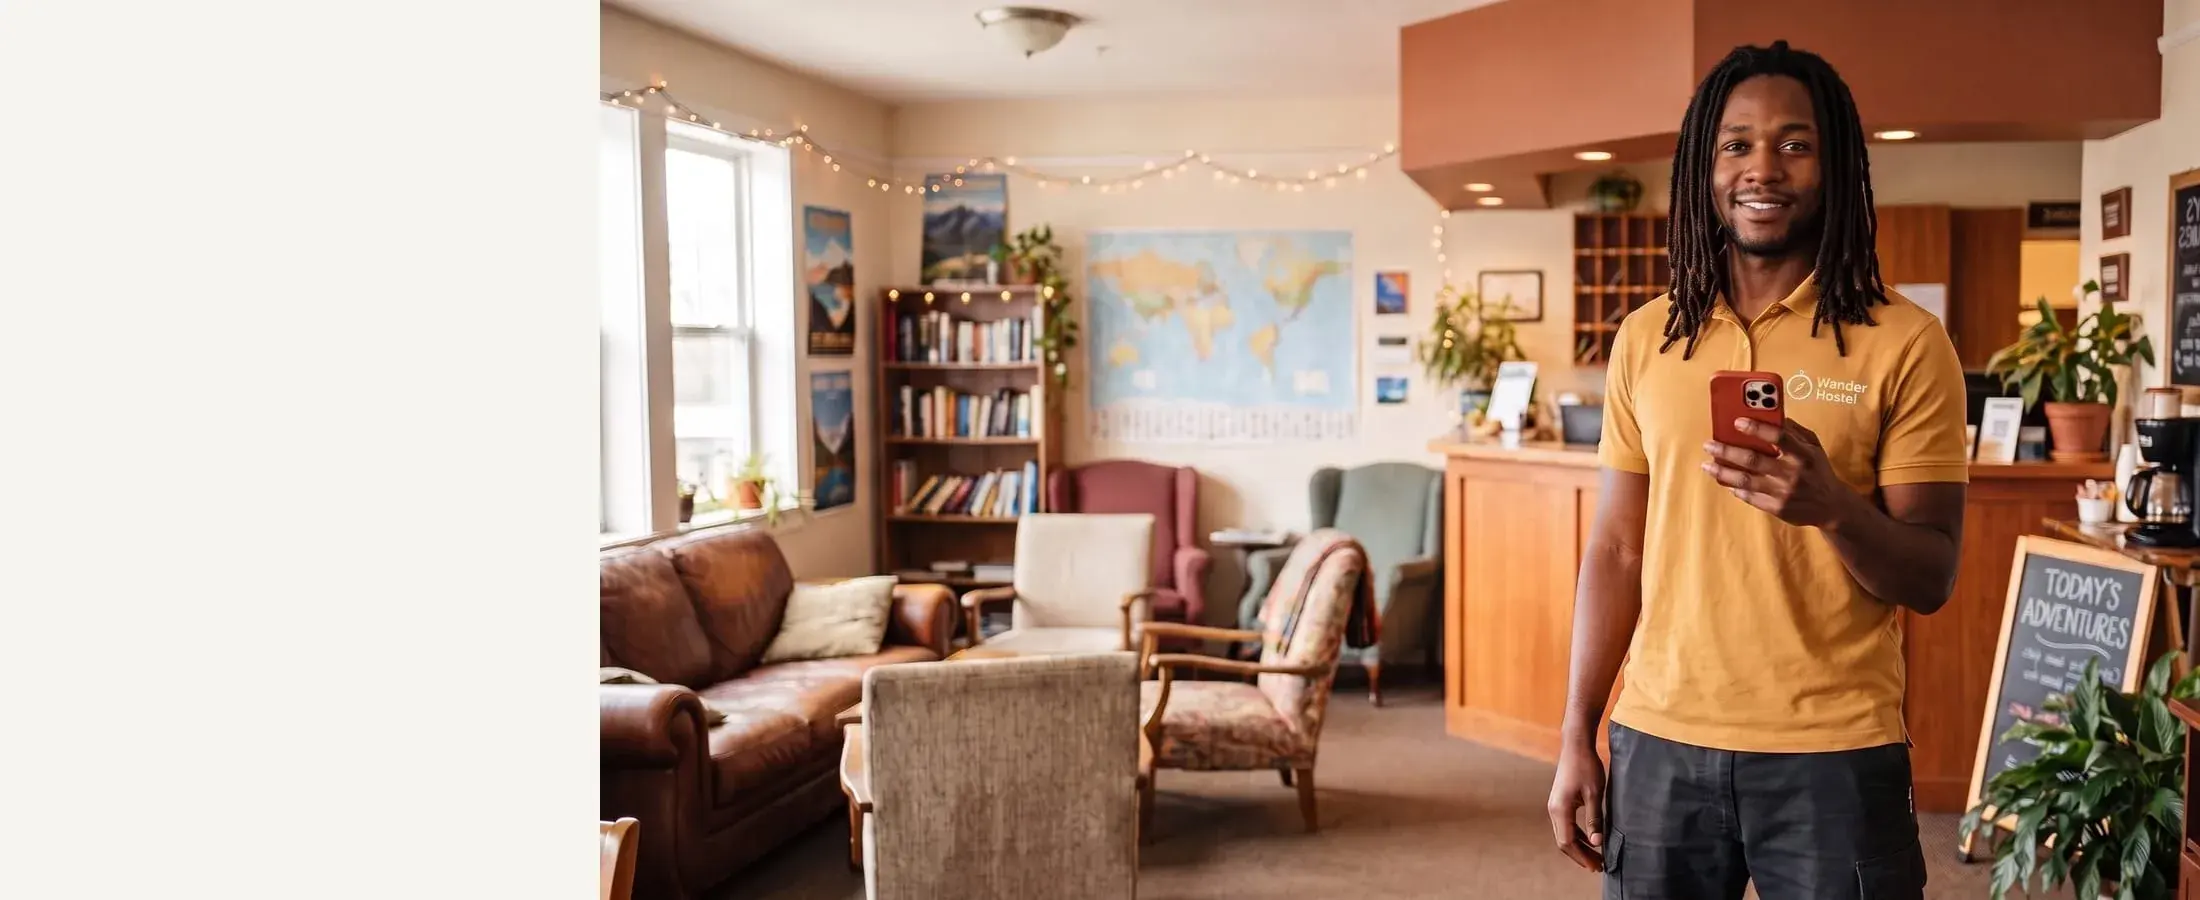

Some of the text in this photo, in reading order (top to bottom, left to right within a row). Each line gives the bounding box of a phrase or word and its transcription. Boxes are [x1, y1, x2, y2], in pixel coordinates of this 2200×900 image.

[1816, 389, 1857, 404] Hostel
[1817, 377, 1868, 394] Wander
[2044, 568, 2123, 611] TODAY'S
[2020, 597, 2130, 650] ADVENTURES
